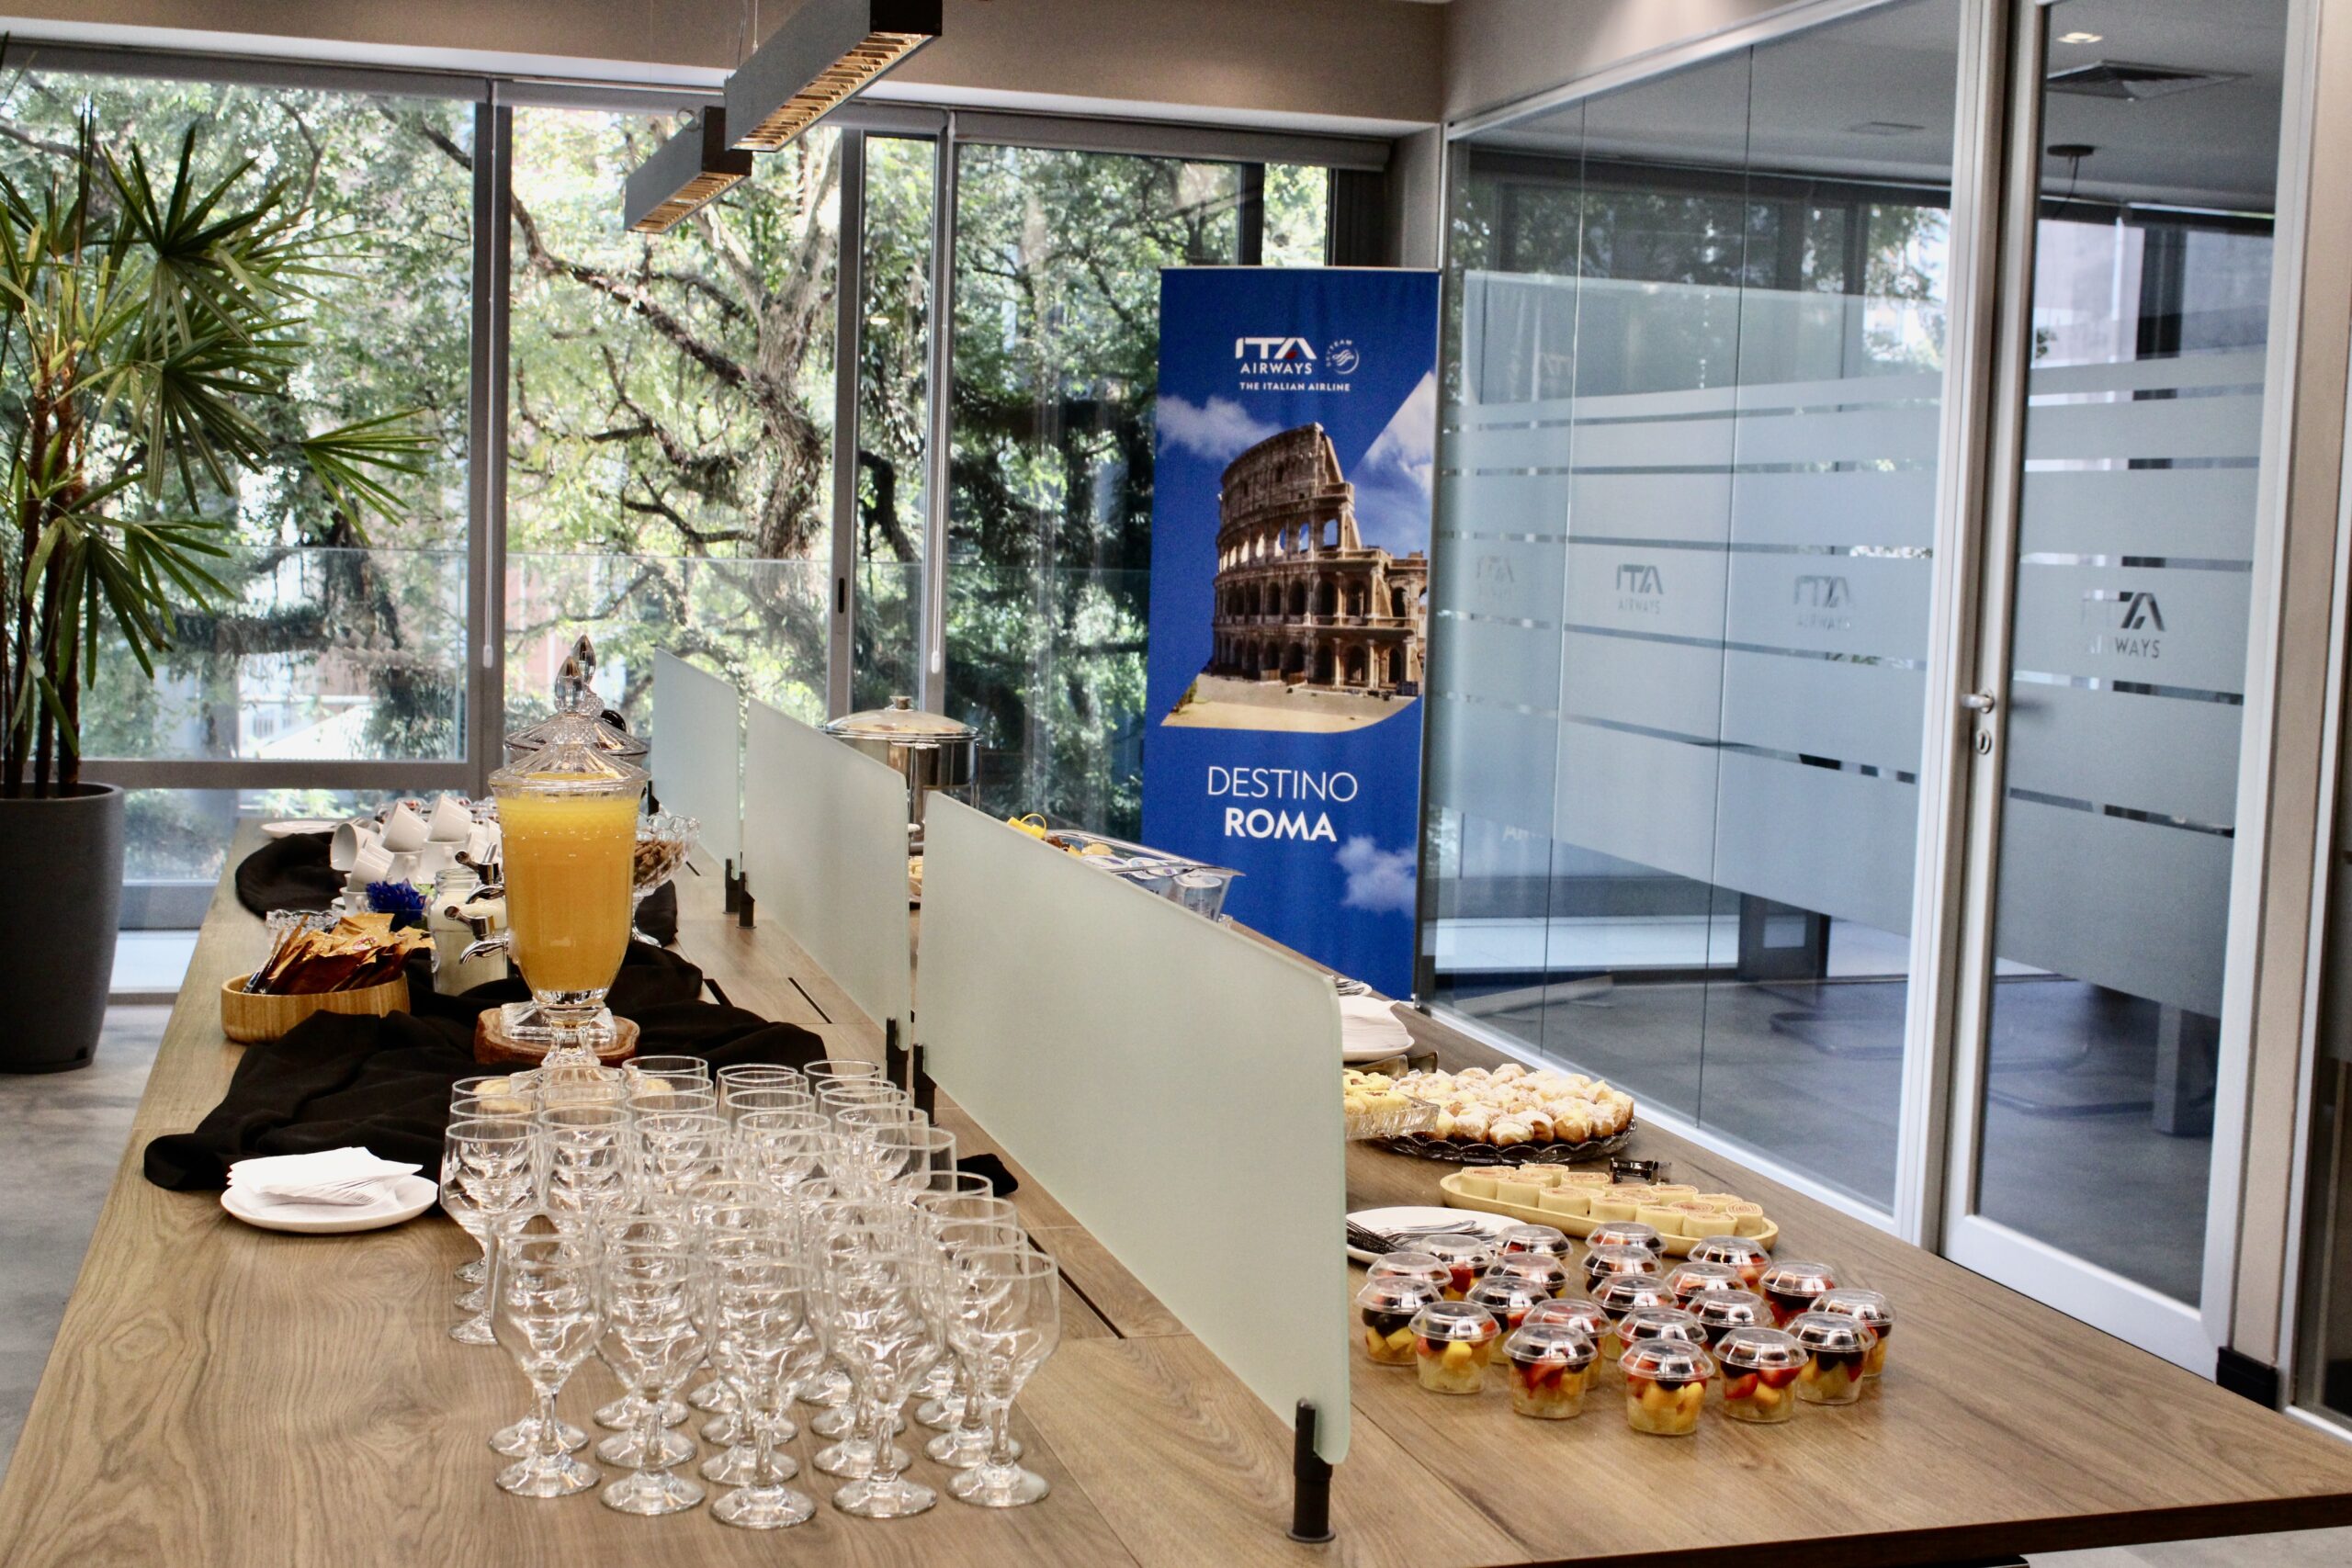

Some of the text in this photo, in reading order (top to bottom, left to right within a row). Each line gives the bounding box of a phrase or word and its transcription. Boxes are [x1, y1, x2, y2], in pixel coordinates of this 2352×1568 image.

[1235, 337, 1317, 360] ITA
[1240, 363, 1313, 375] AIRWAYS
[1239, 382, 1351, 392] THE ITALIAN AIRLINE
[1616, 564, 1664, 594] ITA
[1618, 598, 1660, 615] AIRWAYS
[1207, 766, 1358, 802] DESTINO
[1225, 807, 1338, 842] ROMA
